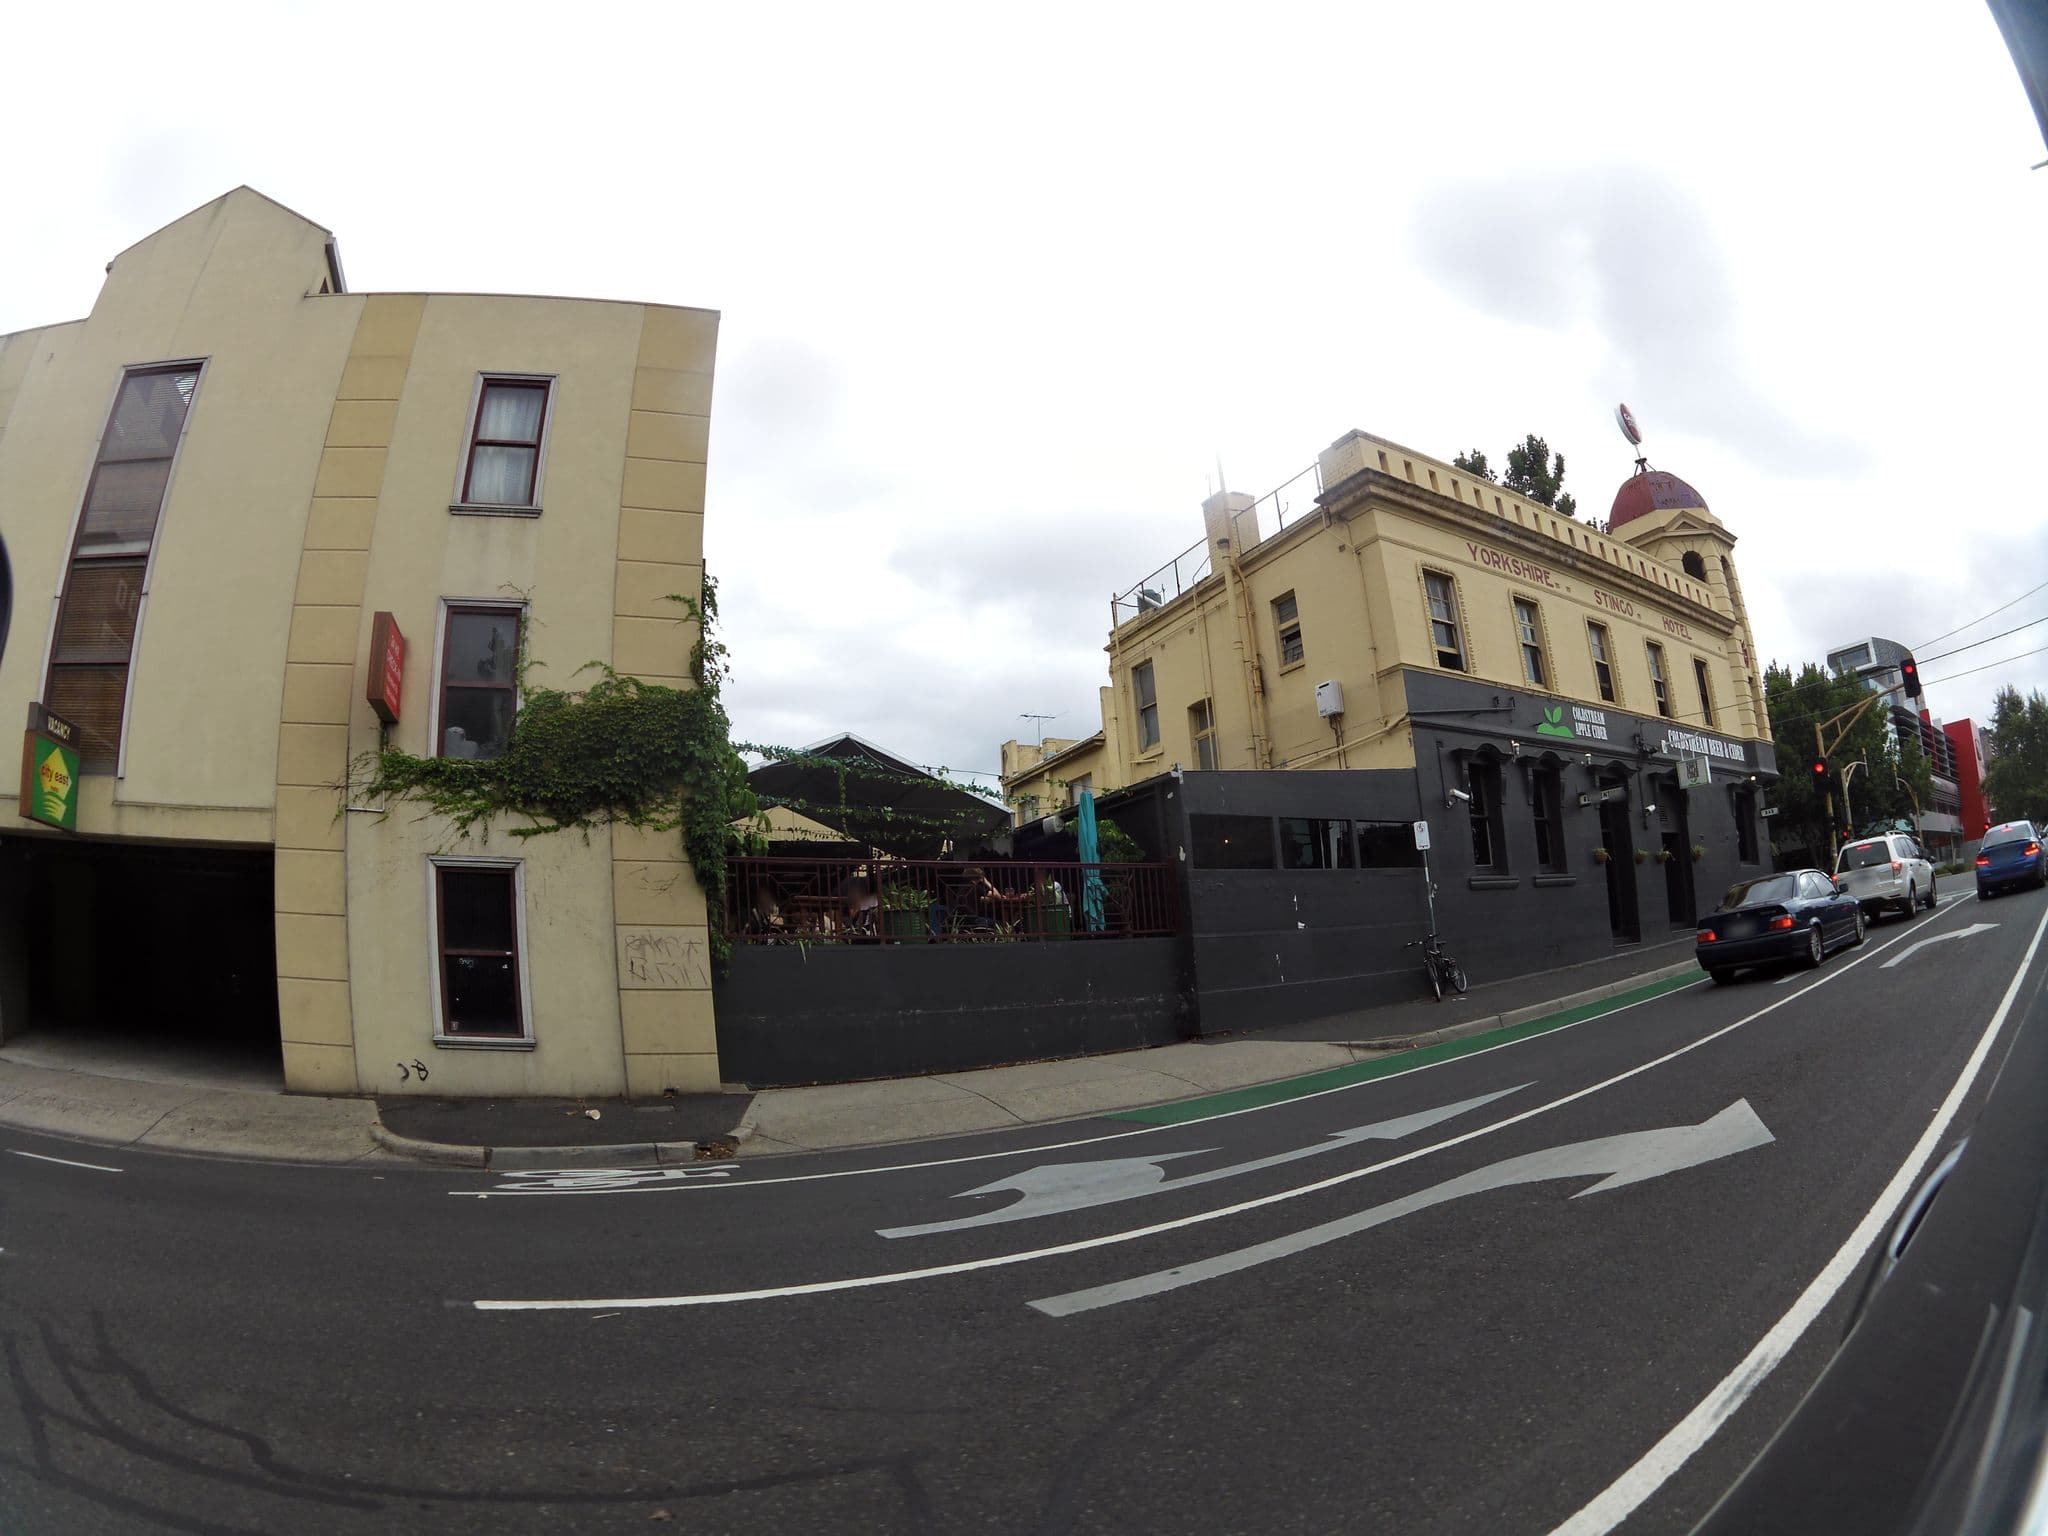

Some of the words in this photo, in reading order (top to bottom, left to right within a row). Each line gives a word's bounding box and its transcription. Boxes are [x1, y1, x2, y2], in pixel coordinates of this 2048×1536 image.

[1467, 543, 1554, 588] YORKSHIRE
[1662, 616, 1692, 640] HOTEL
[1572, 706, 1605, 725] COLDSTREAM
[1575, 721, 1591, 737] APPLE
[1592, 725, 1608, 740] CIDER
